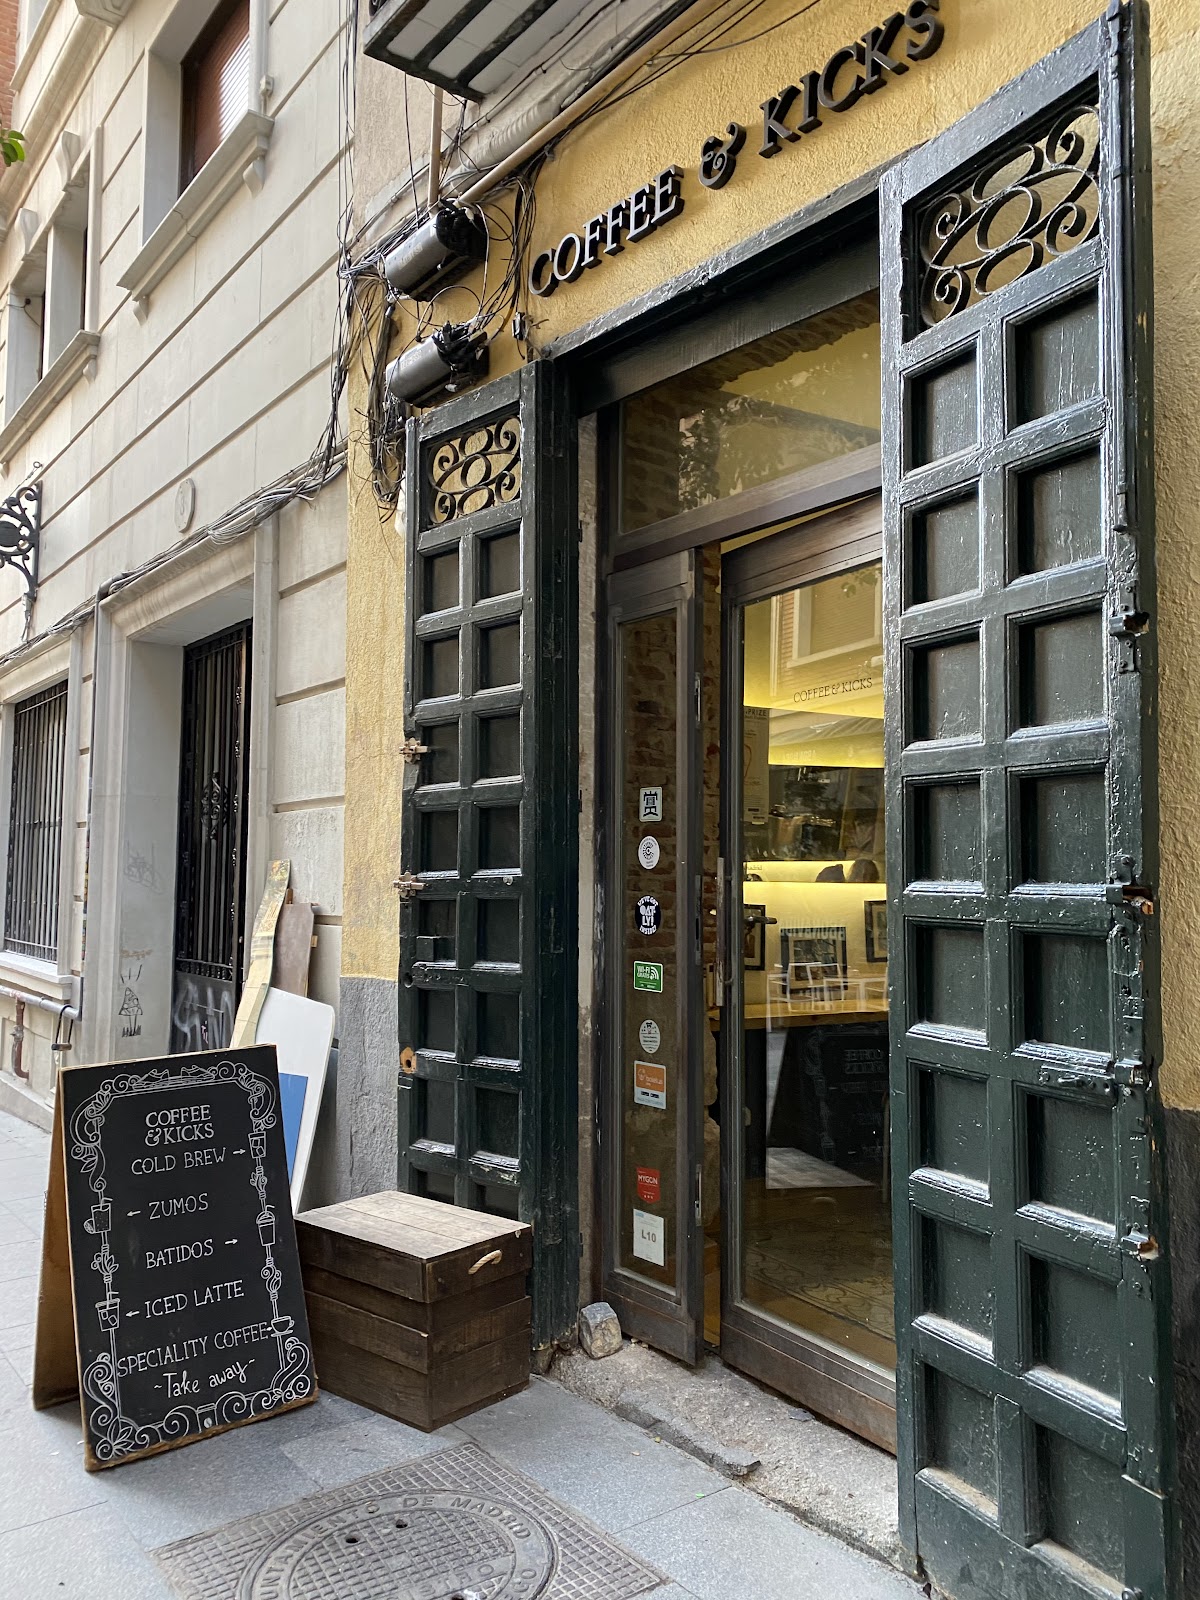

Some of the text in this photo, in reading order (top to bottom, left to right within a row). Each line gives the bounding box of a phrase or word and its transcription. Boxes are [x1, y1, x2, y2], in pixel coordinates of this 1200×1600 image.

[528, 0, 946, 297] COFFEE & KICKS
[793, 677, 873, 703] COFFEE & KICKS
[145, 1105, 212, 1128] COFFEE
[131, 1146, 226, 1175] COLD BREW
[149, 1192, 209, 1220] ZUMOS
[641, 1229, 657, 1243] L10
[145, 1238, 214, 1269] BATIDOS
[144, 1279, 245, 1319] ICED LATTE
[117, 1321, 269, 1378] SPECIALITY COFFEE
[162, 1360, 248, 1398] Take away
[402, 1495, 435, 1509] DE
[450, 1496, 532, 1540] MADRID
